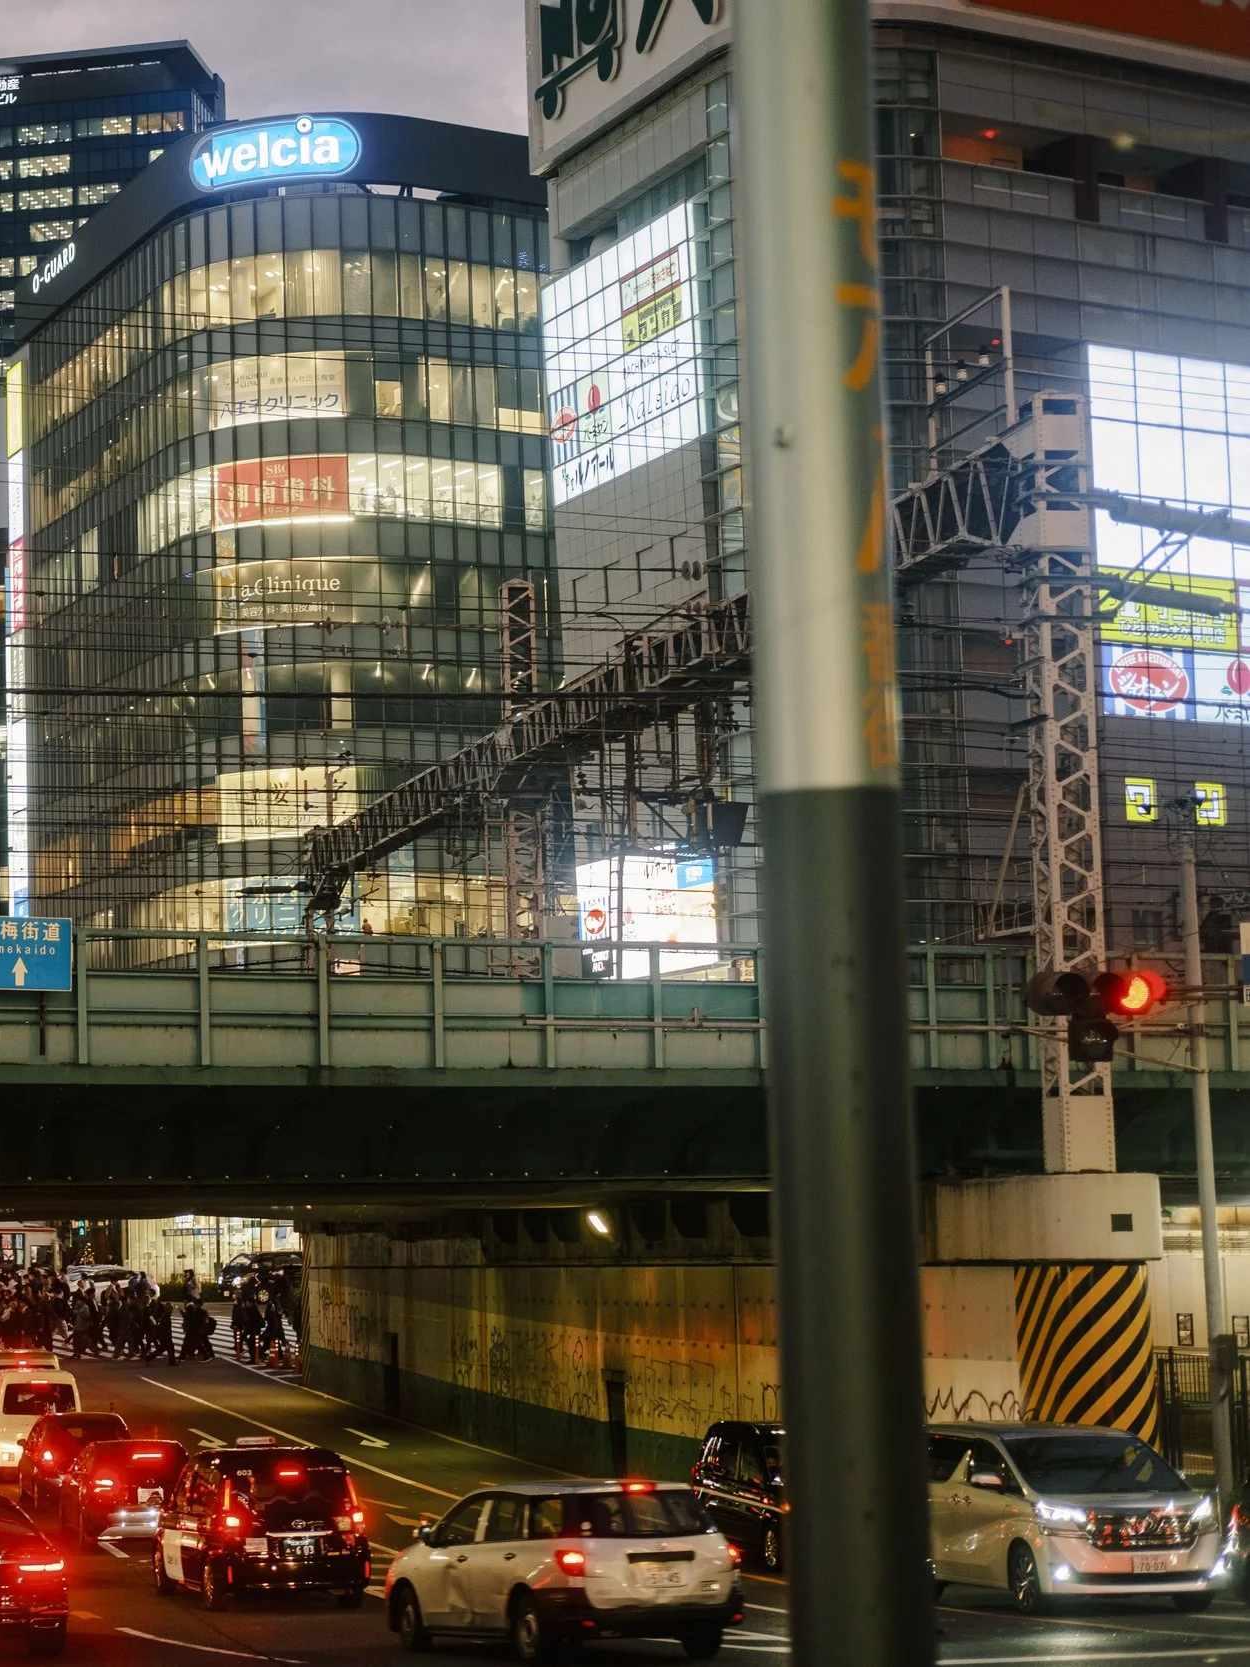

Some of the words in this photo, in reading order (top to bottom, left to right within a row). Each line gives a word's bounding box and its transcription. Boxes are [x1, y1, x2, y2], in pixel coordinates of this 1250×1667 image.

[202, 117, 340, 179] welcia
[32, 242, 76, 294] O-GUARD
[220, 393, 339, 418] 八王子クリニック
[236, 1469, 253, 1477] 603
